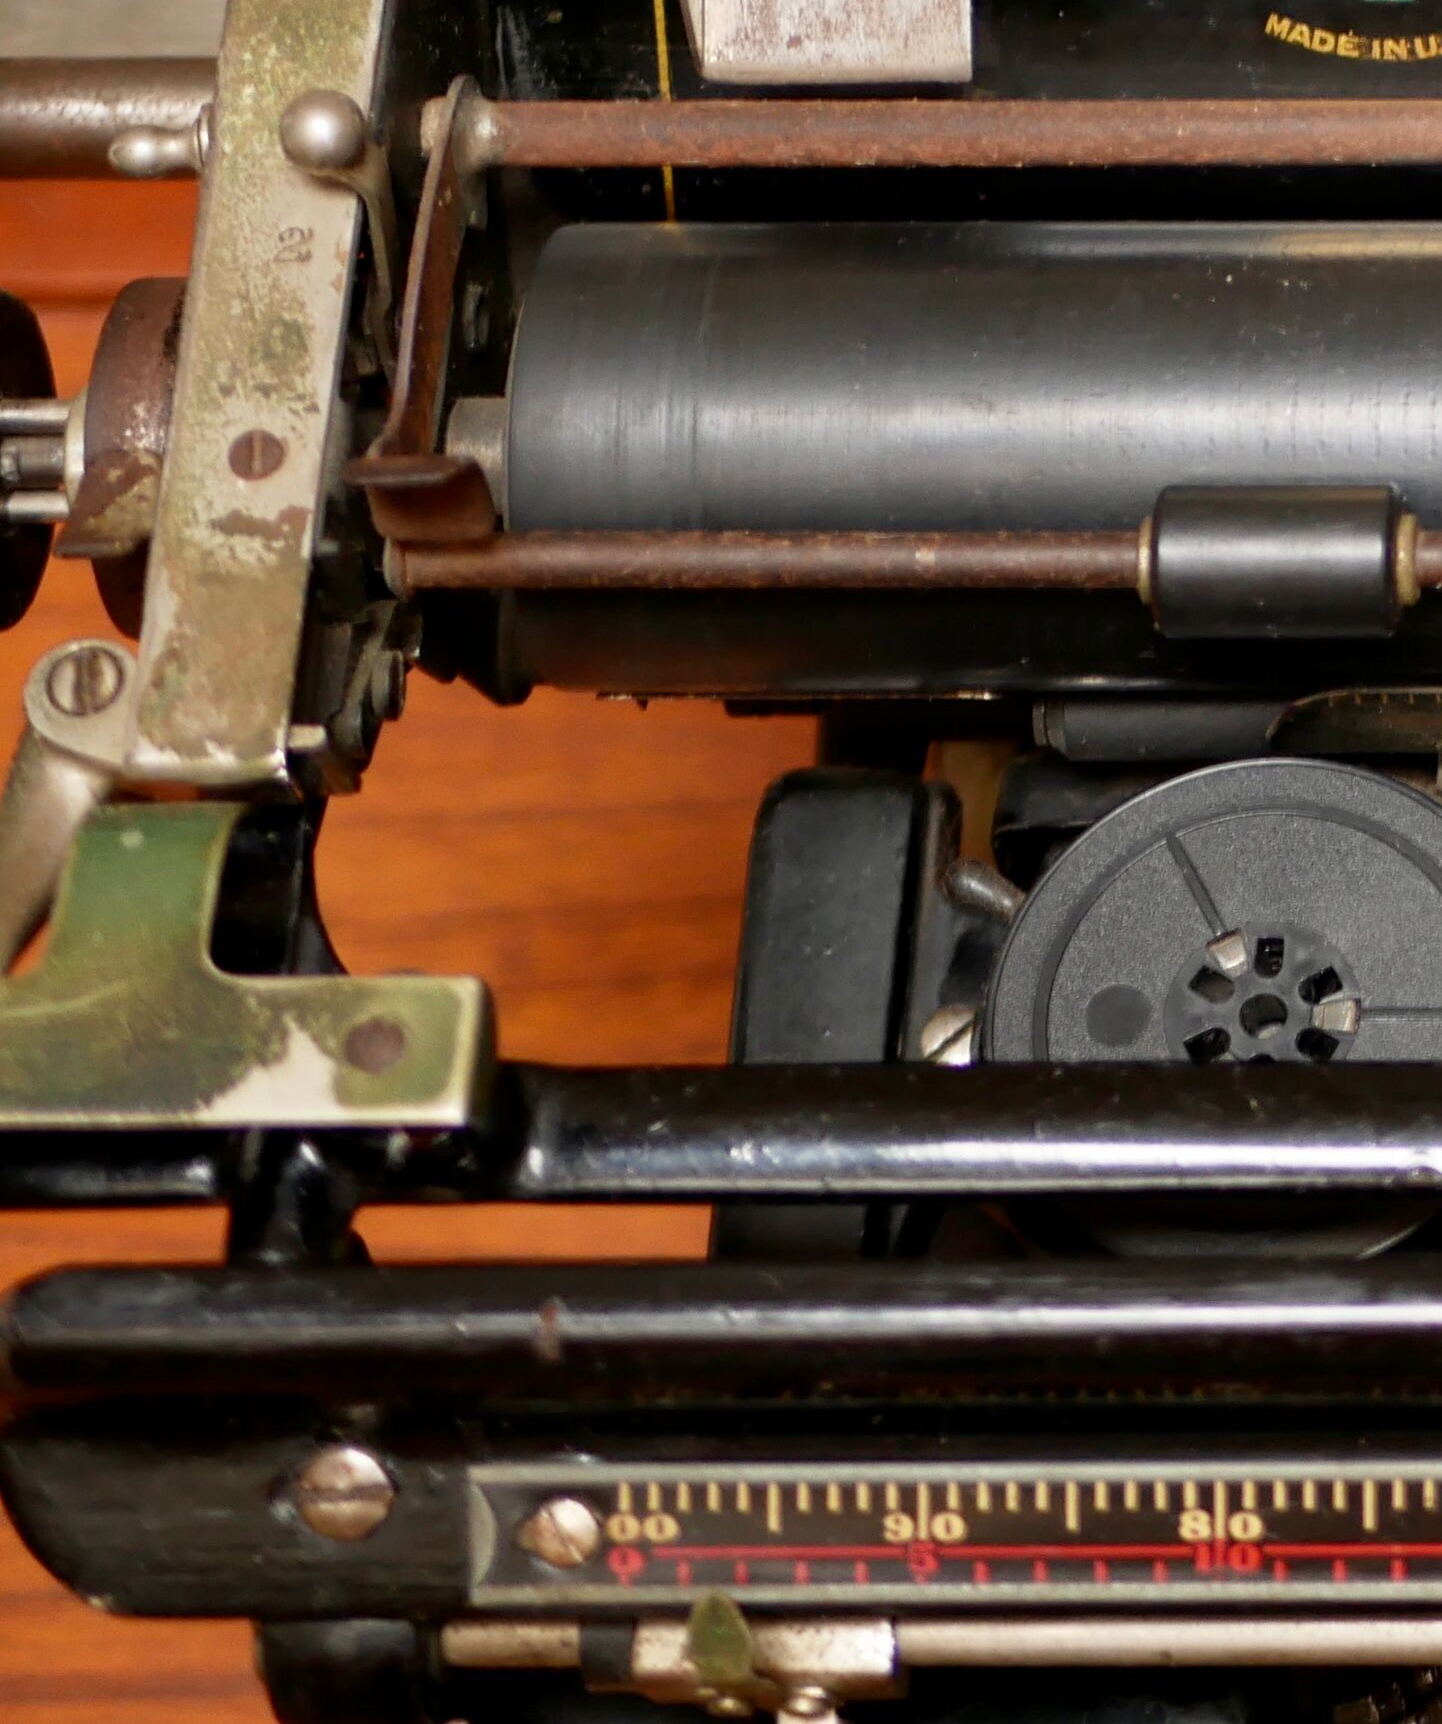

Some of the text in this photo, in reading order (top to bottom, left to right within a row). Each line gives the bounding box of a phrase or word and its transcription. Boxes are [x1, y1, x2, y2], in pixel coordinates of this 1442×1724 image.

[1264, 12, 1361, 59] MADE
[1371, 36, 1409, 62] IN
[883, 1512, 967, 1543] 90
[1178, 1508, 1265, 1542] 80
[607, 1544, 647, 1576] 0
[907, 1541, 941, 1575] 5
[1193, 1540, 1263, 1573] 10
